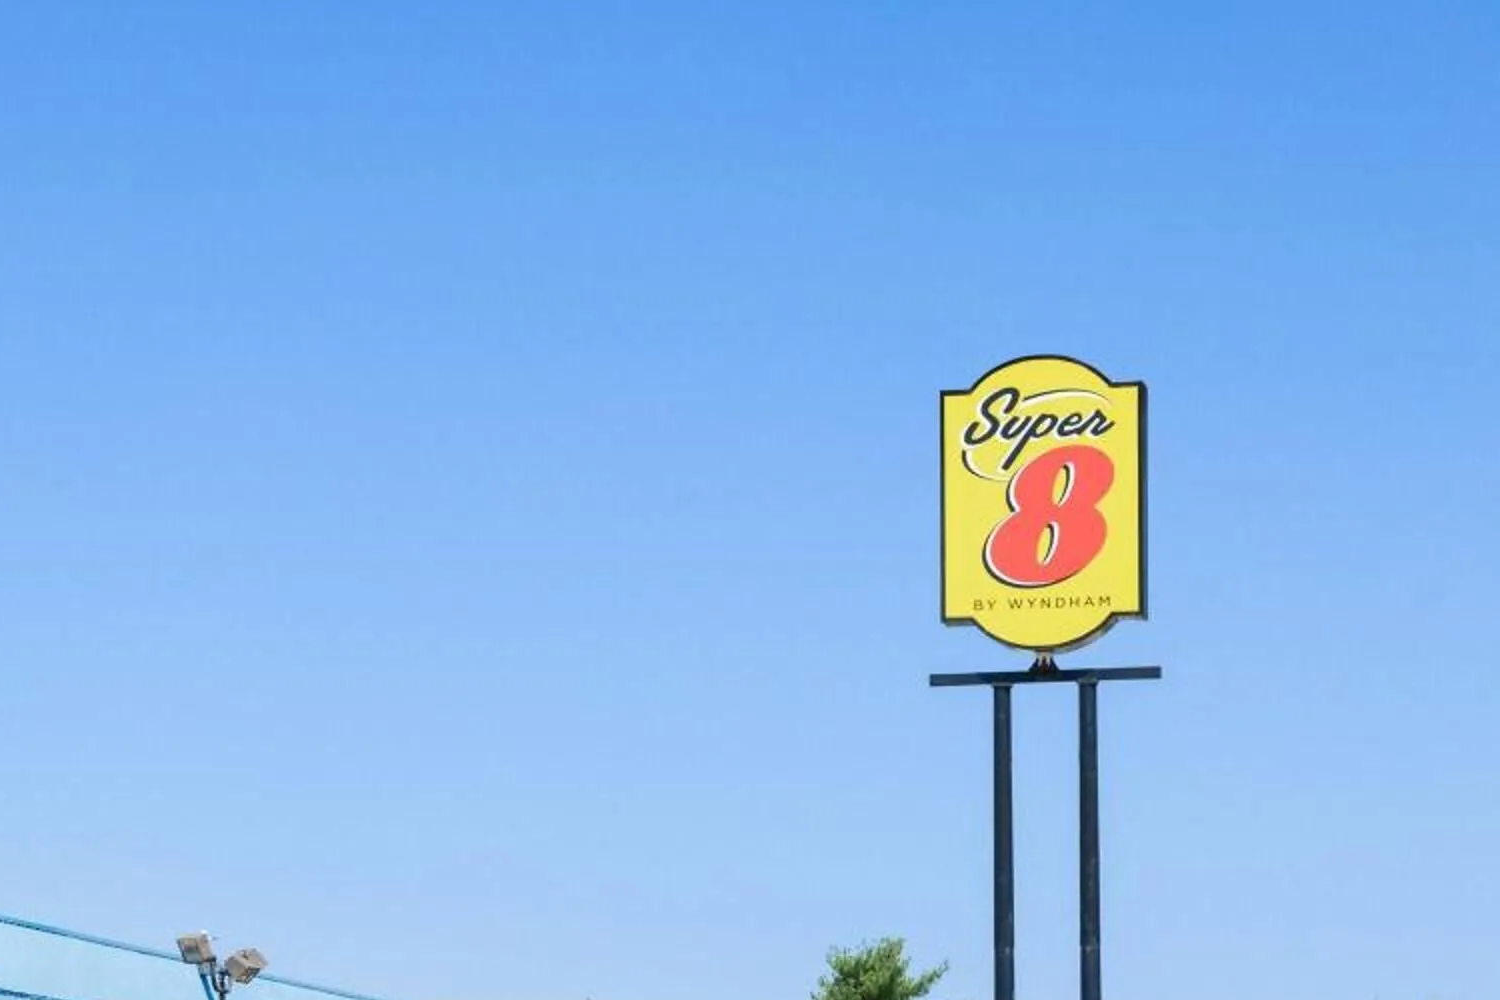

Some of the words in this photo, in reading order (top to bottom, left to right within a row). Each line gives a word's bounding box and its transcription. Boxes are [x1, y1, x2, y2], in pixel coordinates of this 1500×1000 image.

[963, 387, 1116, 471] Super
[982, 444, 1115, 588] 8
[973, 599, 996, 611] BY
[1008, 596, 1112, 610] WYNDHAM
